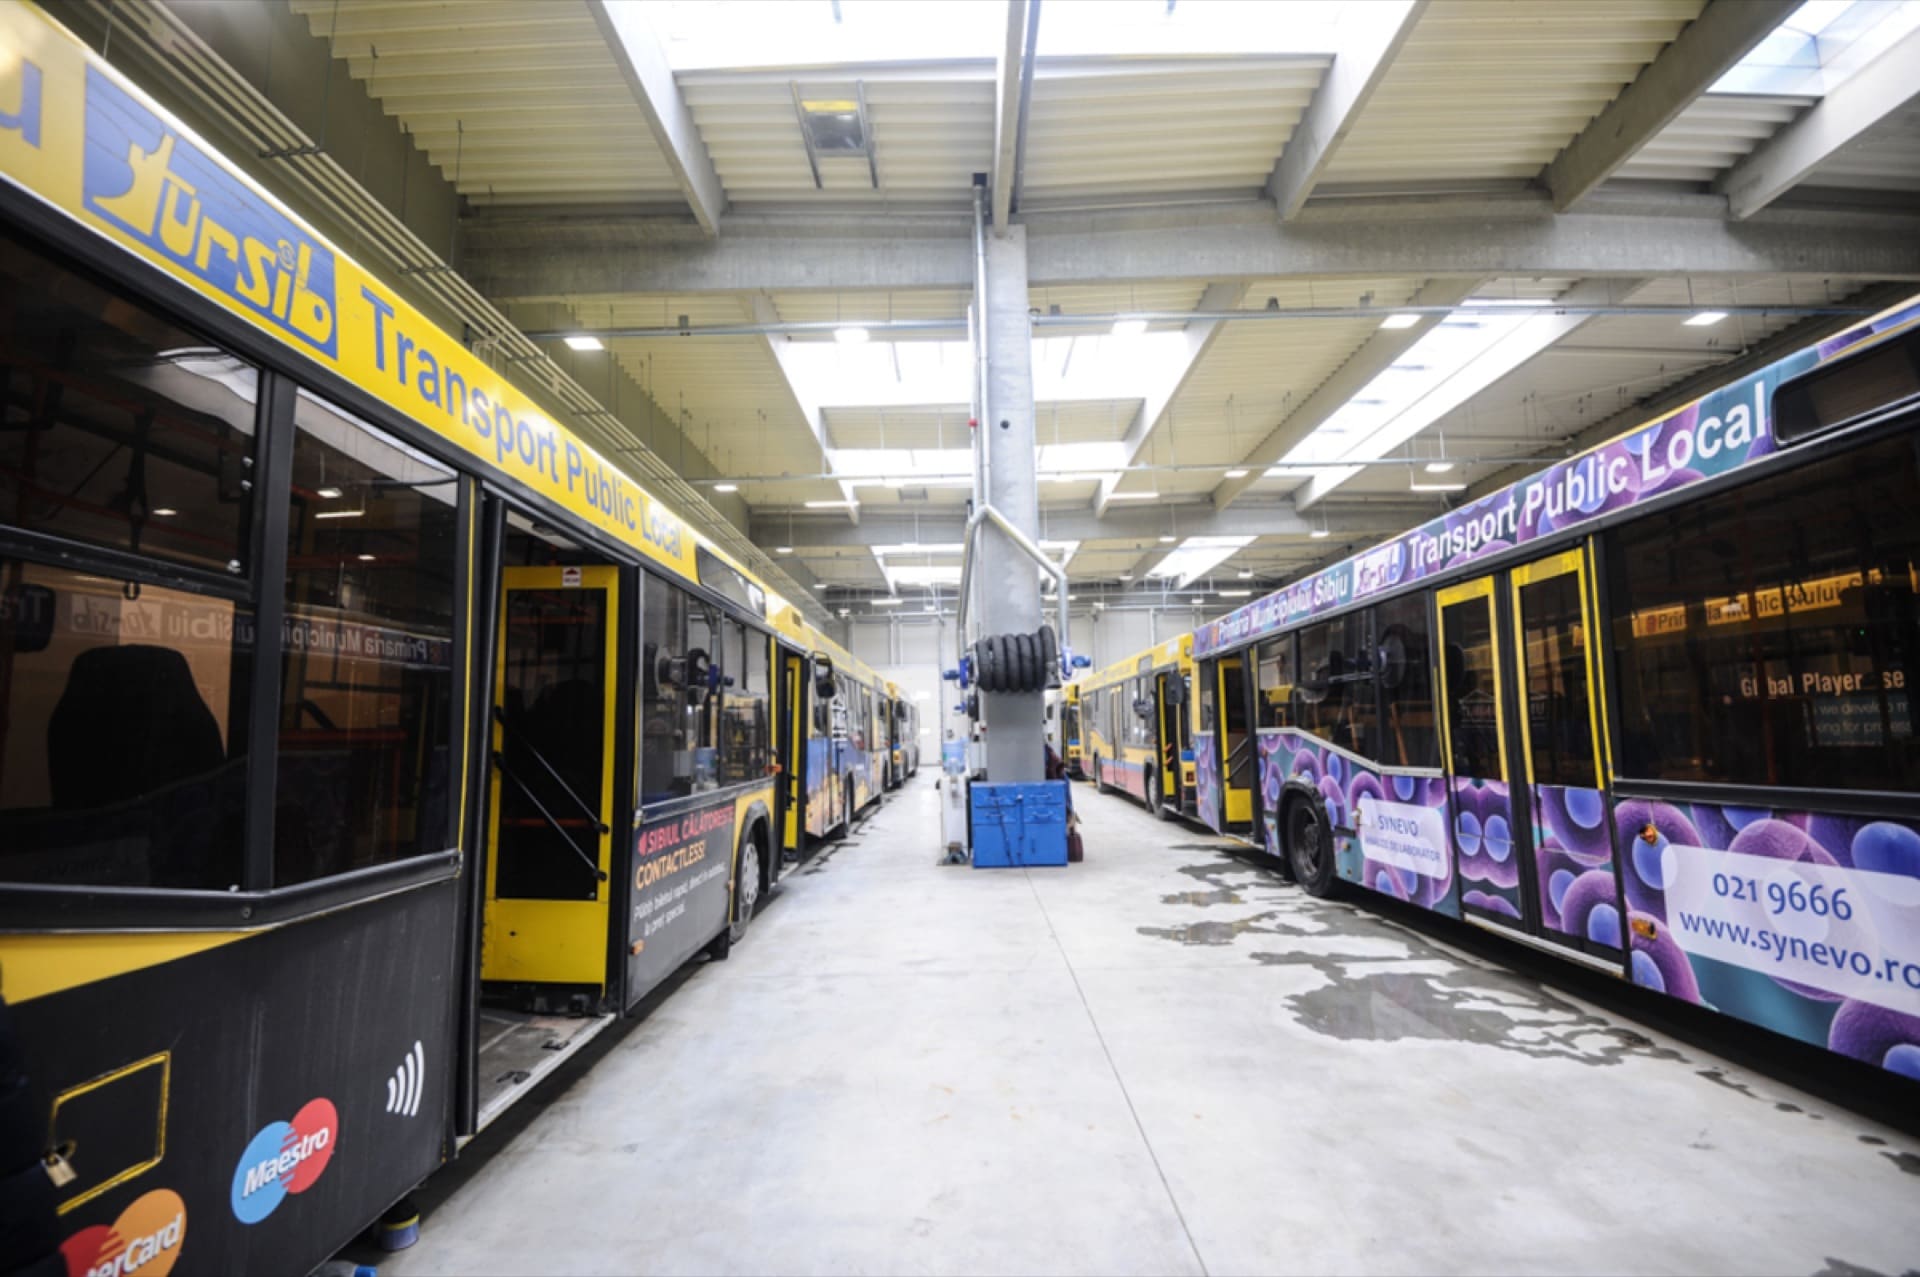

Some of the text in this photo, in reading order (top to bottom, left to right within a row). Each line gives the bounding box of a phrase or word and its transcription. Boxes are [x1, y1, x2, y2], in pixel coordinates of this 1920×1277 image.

[361, 285, 683, 560] Transport Public Local
[1314, 570, 1348, 606] Sibiu
[1408, 493, 1517, 570] Transport
[1525, 453, 1628, 524] Public
[1642, 381, 1765, 481] Local
[1741, 676, 1794, 698] Glbal
[1802, 672, 1863, 697] Player
[647, 823, 681, 855] SIBIUL
[1713, 873, 1852, 920] 021 9666
[1680, 911, 1920, 990] www.synevo.ro
[242, 1127, 330, 1199] Maestro
